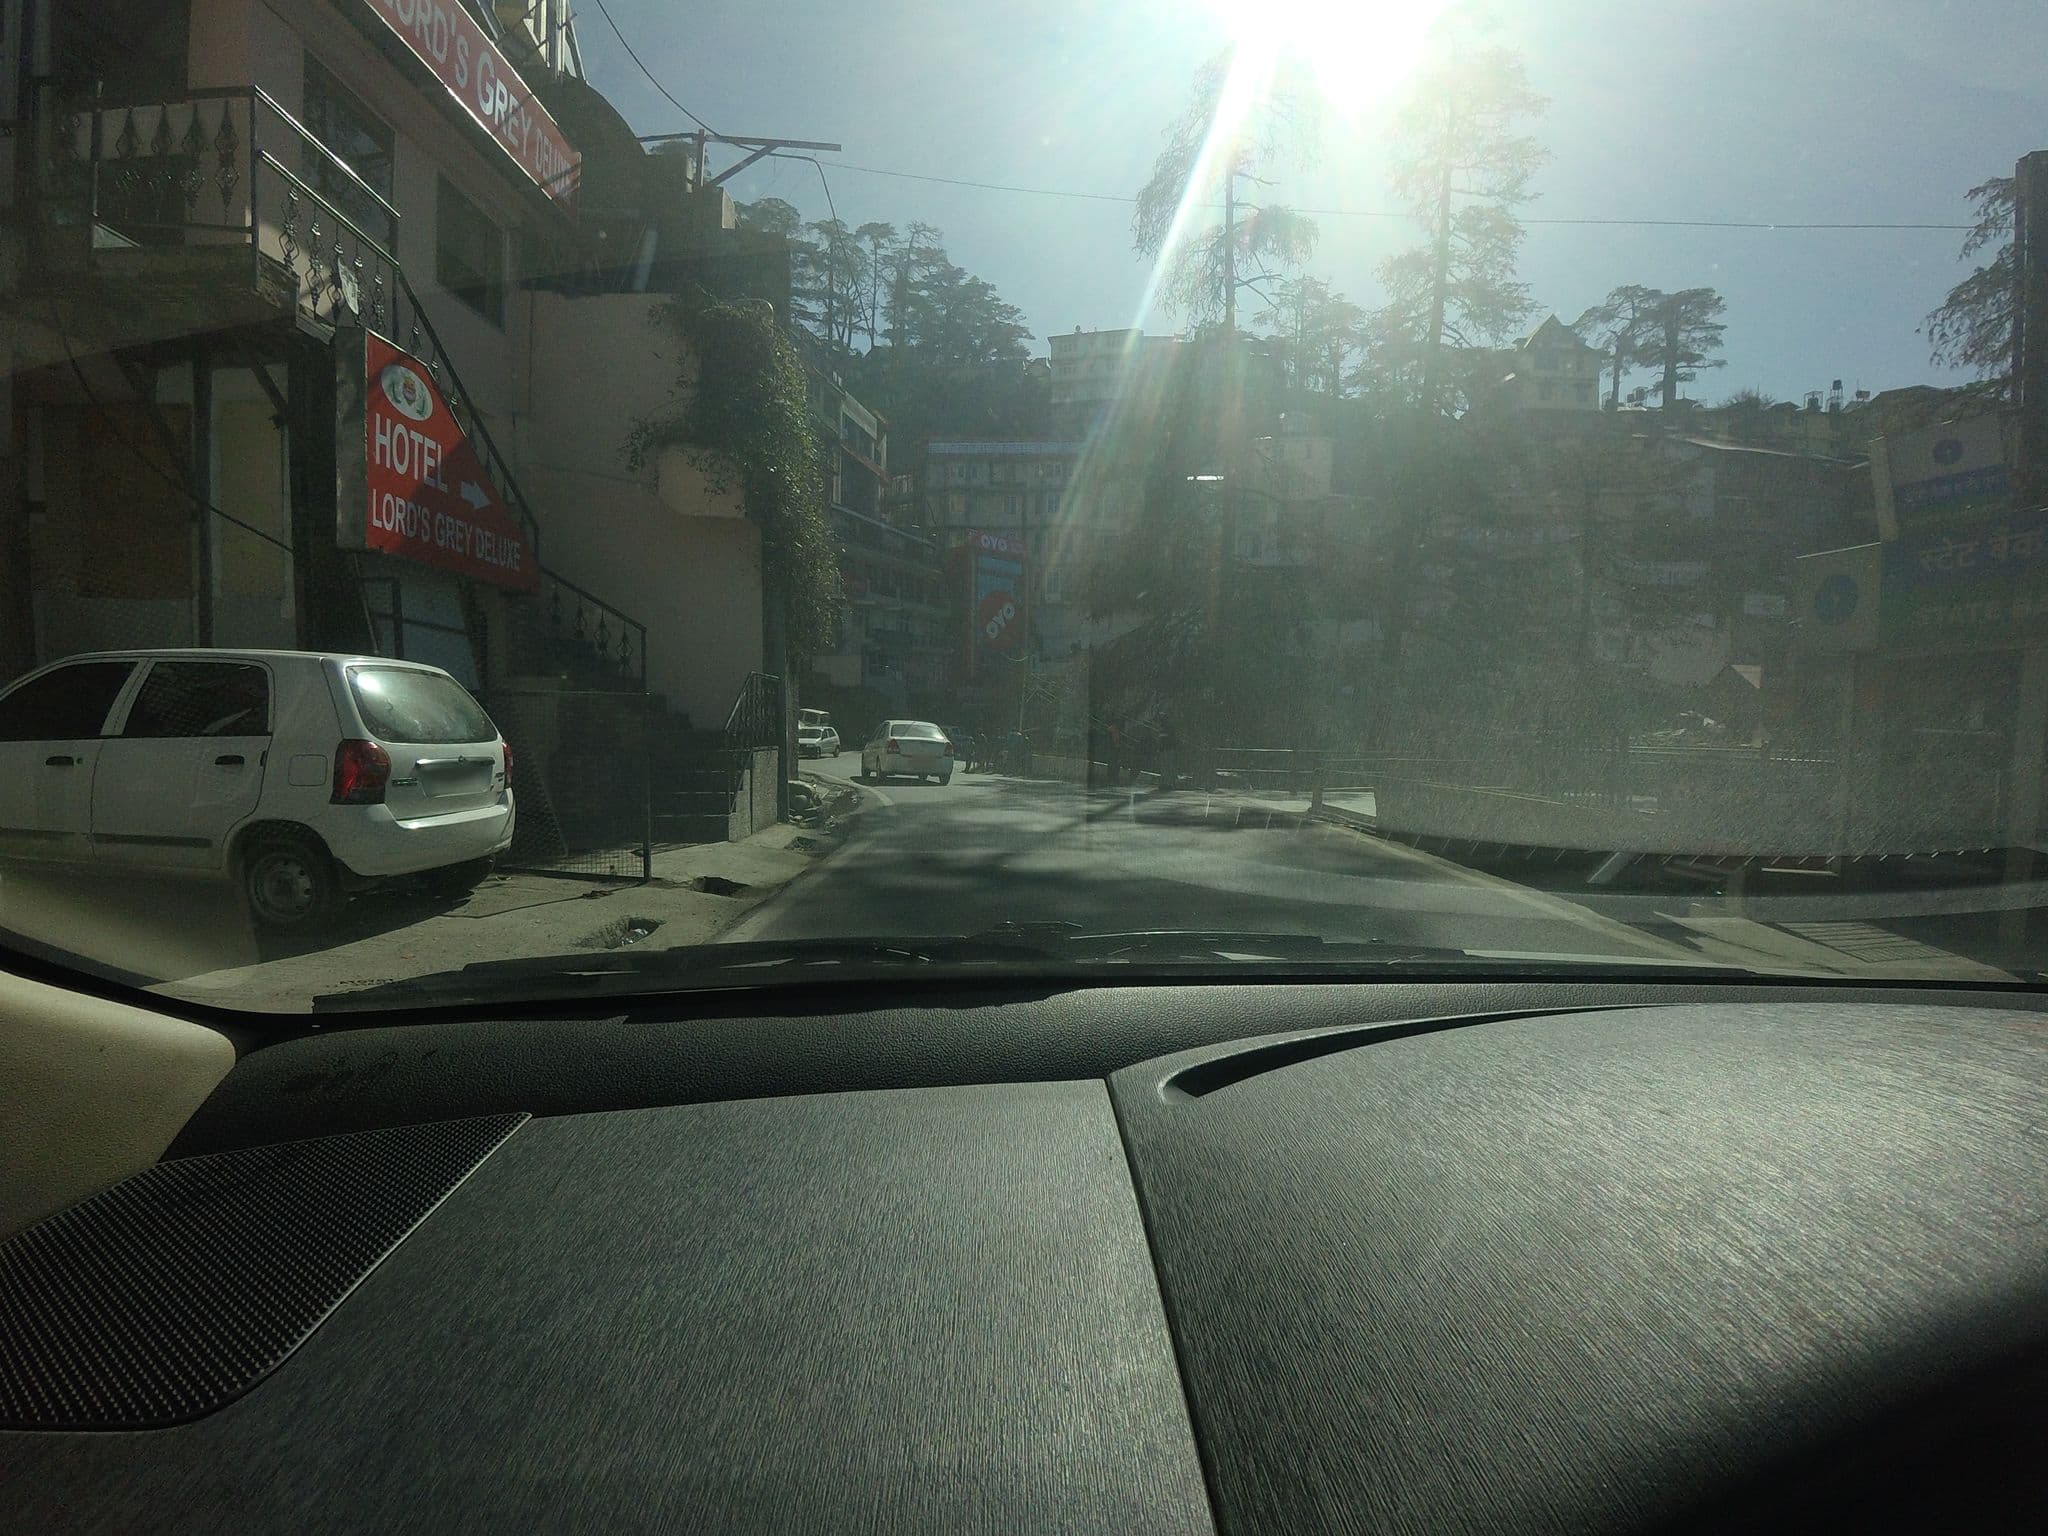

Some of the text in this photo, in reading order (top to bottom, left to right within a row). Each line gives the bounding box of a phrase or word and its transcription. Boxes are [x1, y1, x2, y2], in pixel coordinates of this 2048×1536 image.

[381, 0, 469, 89] RD'S
[477, 51, 532, 157] GREY
[374, 412, 449, 495] HOTEL
[371, 487, 521, 573] LORD'S GREY DELUXE
